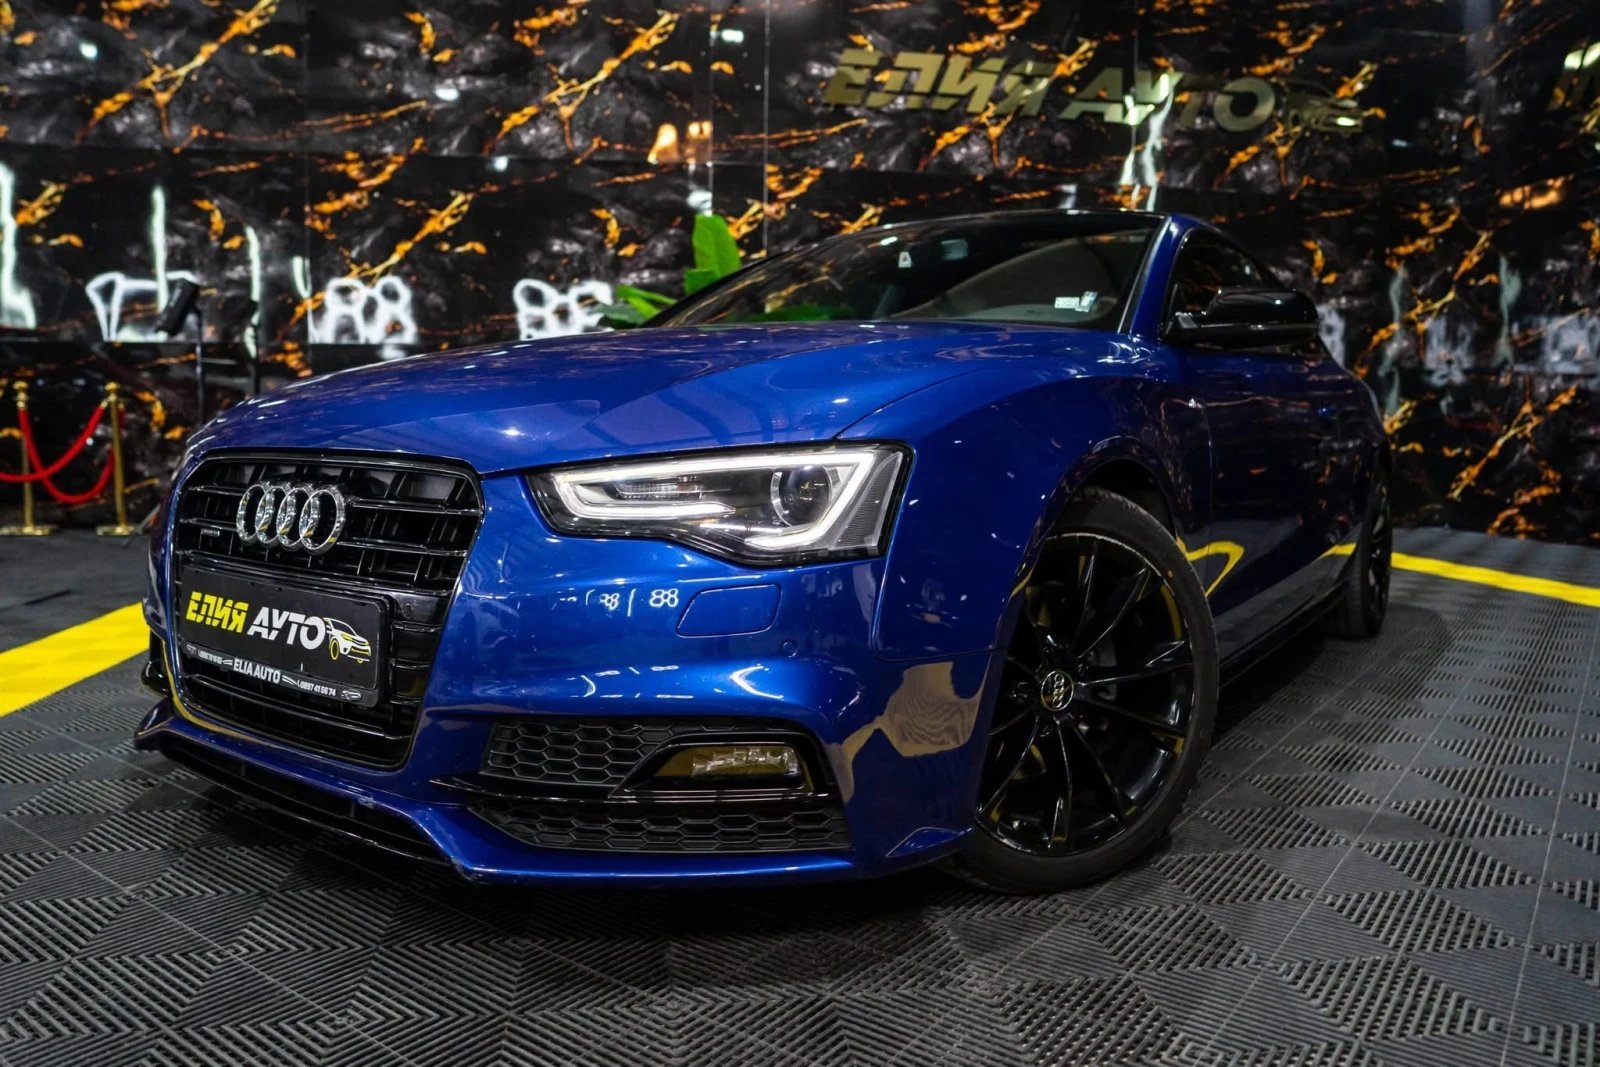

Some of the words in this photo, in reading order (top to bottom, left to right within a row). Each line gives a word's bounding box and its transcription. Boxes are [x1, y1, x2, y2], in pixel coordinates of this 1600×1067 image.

[186, 591, 249, 633] ЕЛИЯ
[233, 657, 253, 676] ELIA
[253, 664, 281, 684] AUTO
